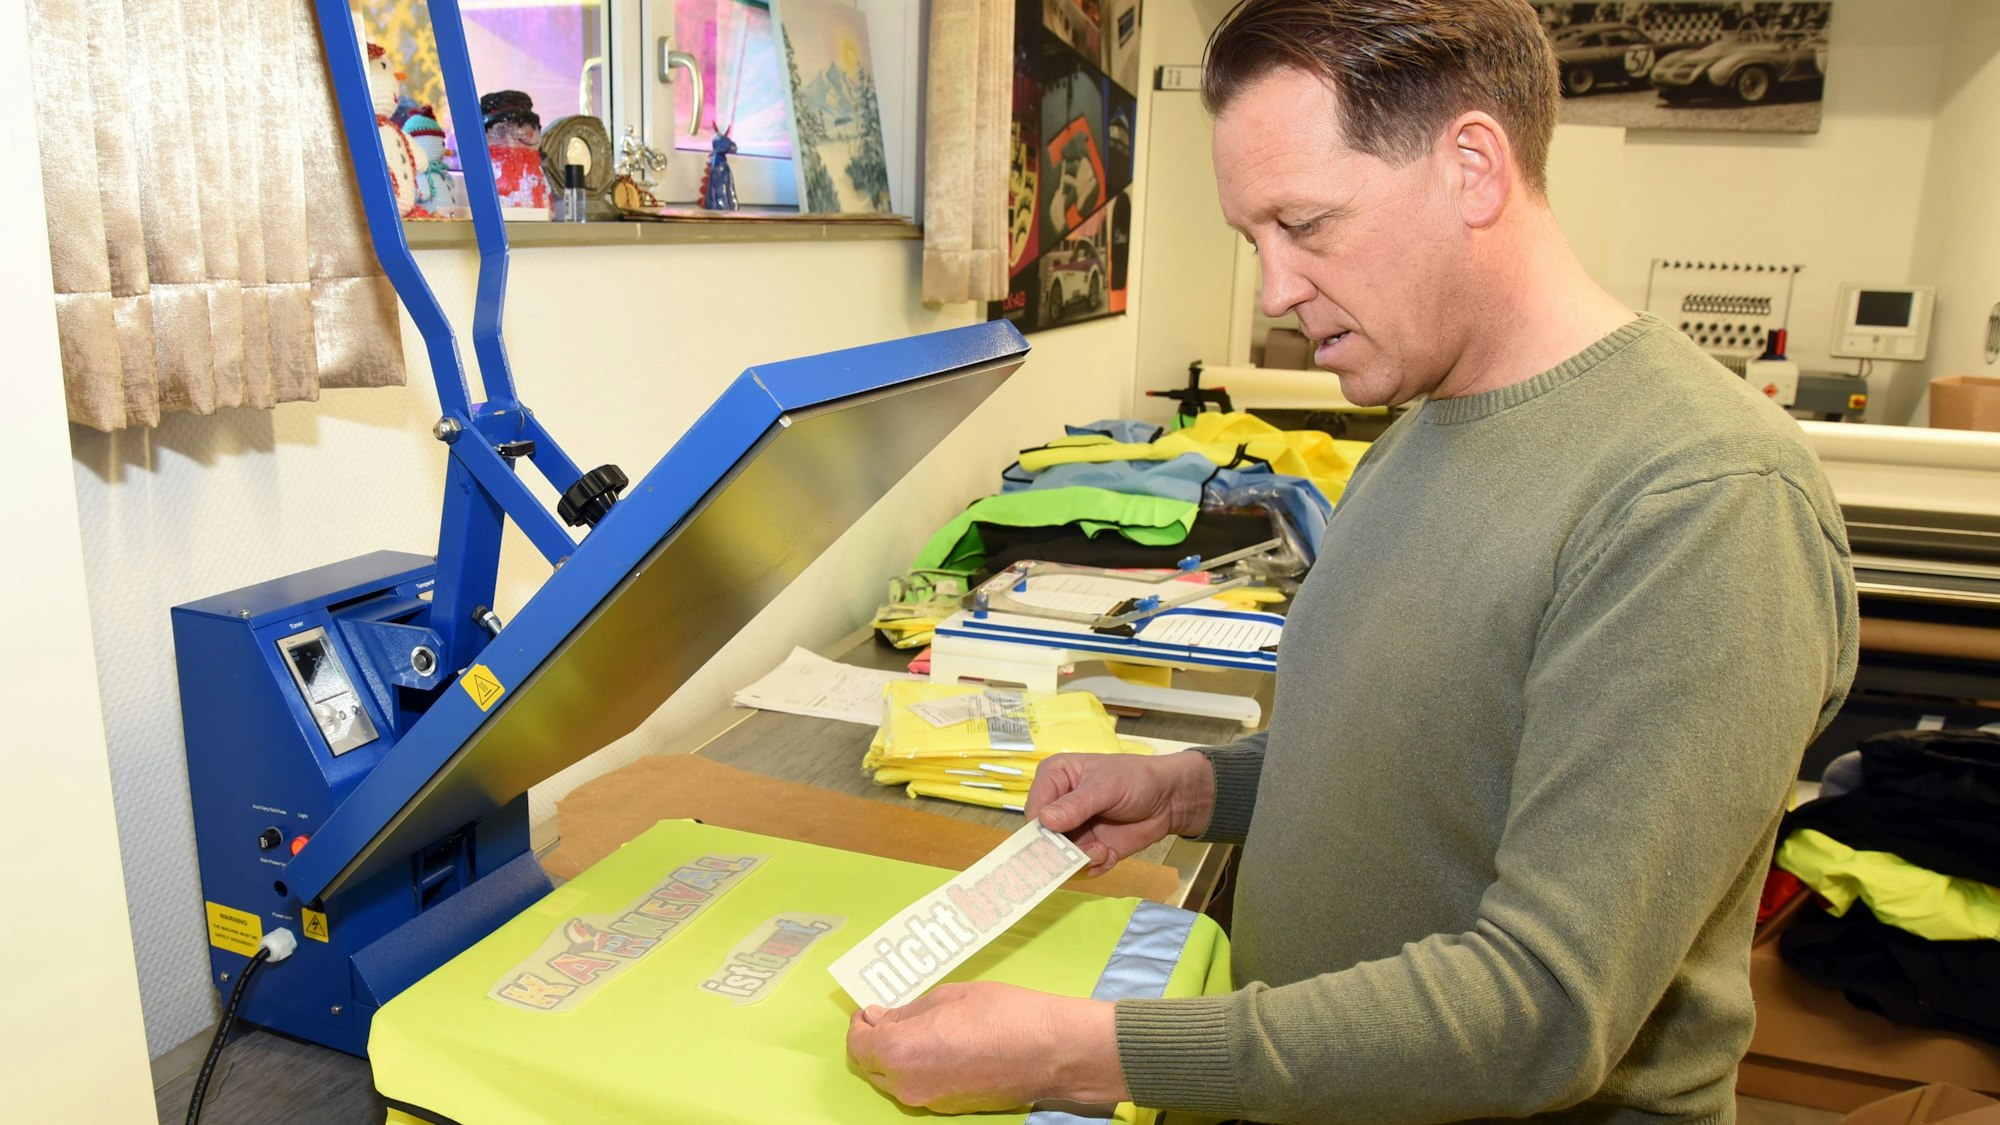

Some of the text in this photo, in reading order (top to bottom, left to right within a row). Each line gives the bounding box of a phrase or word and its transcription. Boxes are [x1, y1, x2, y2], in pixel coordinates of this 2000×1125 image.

[289, 621, 304, 630] Timer
[219, 912, 249, 927] WARNING
[221, 926, 240, 936] MACHINE
[239, 931, 251, 939] MUST
[498, 857, 757, 1009] KARNEVAL
[860, 901, 977, 1006] nicht
[703, 963, 777, 998] ist
